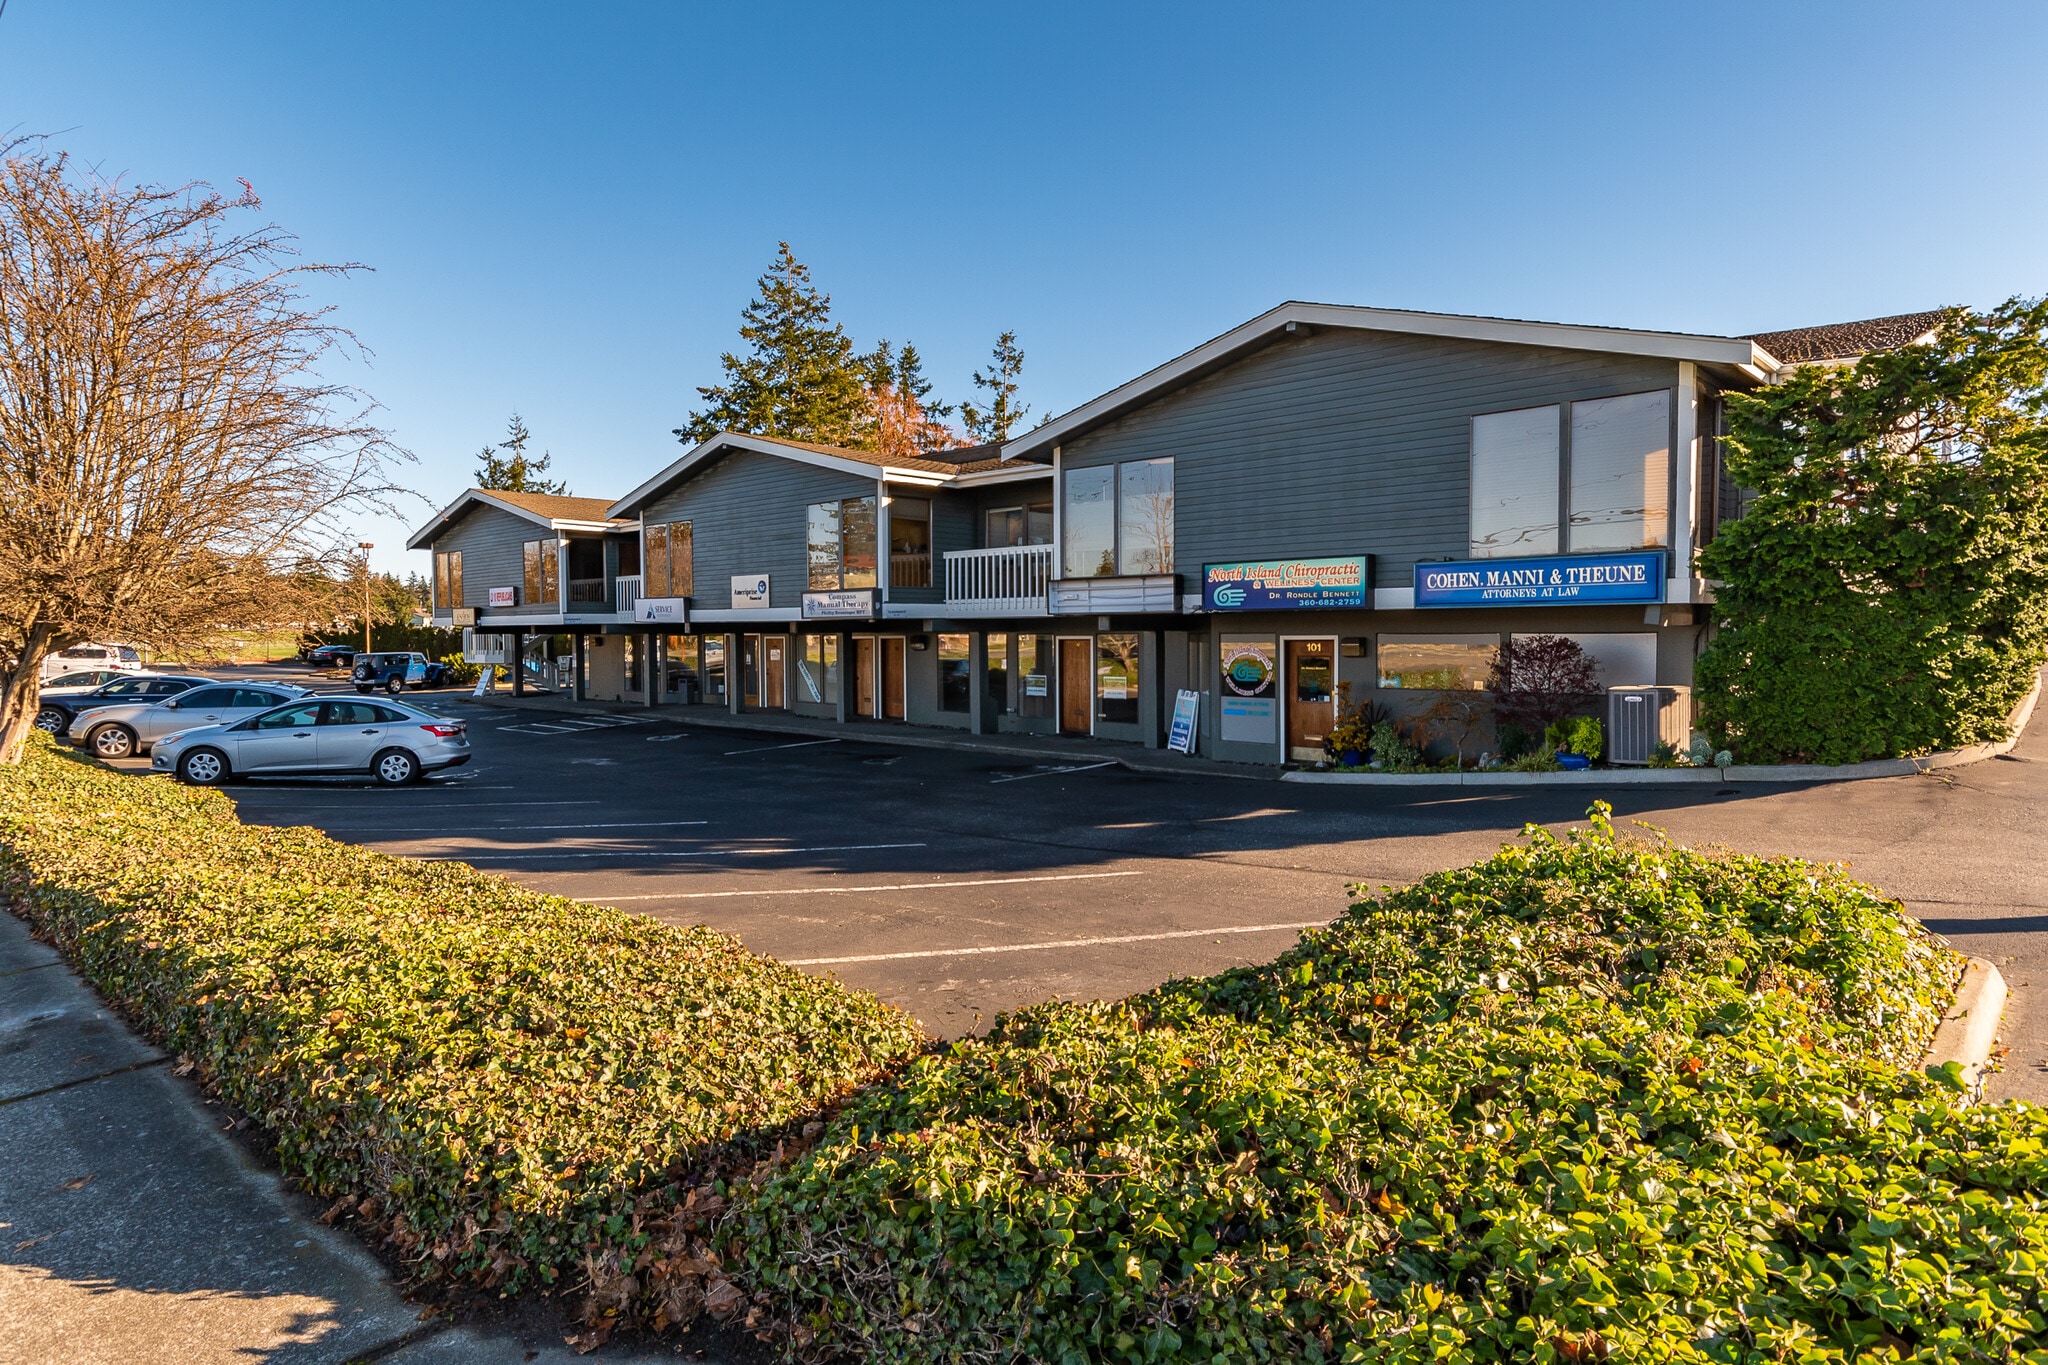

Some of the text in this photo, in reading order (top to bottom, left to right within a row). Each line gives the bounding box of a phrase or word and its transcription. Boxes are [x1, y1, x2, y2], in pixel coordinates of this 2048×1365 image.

[1208, 561, 1360, 582] North Island Chiropractic
[1486, 569, 1545, 587] MANNI
[1549, 568, 1563, 585] &
[1566, 565, 1646, 584] THEUNE
[1265, 578, 1316, 588] WELLNESS
[1320, 576, 1360, 586] CENTER
[828, 593, 857, 601] Compass
[1482, 587, 1580, 599] ATTORNEYS AT LAW
[817, 600, 868, 609] Manual Therapy
[1299, 598, 1361, 606] 360-682-2759
[655, 605, 673, 613] SERVICE
[1306, 643, 1322, 652] 101
